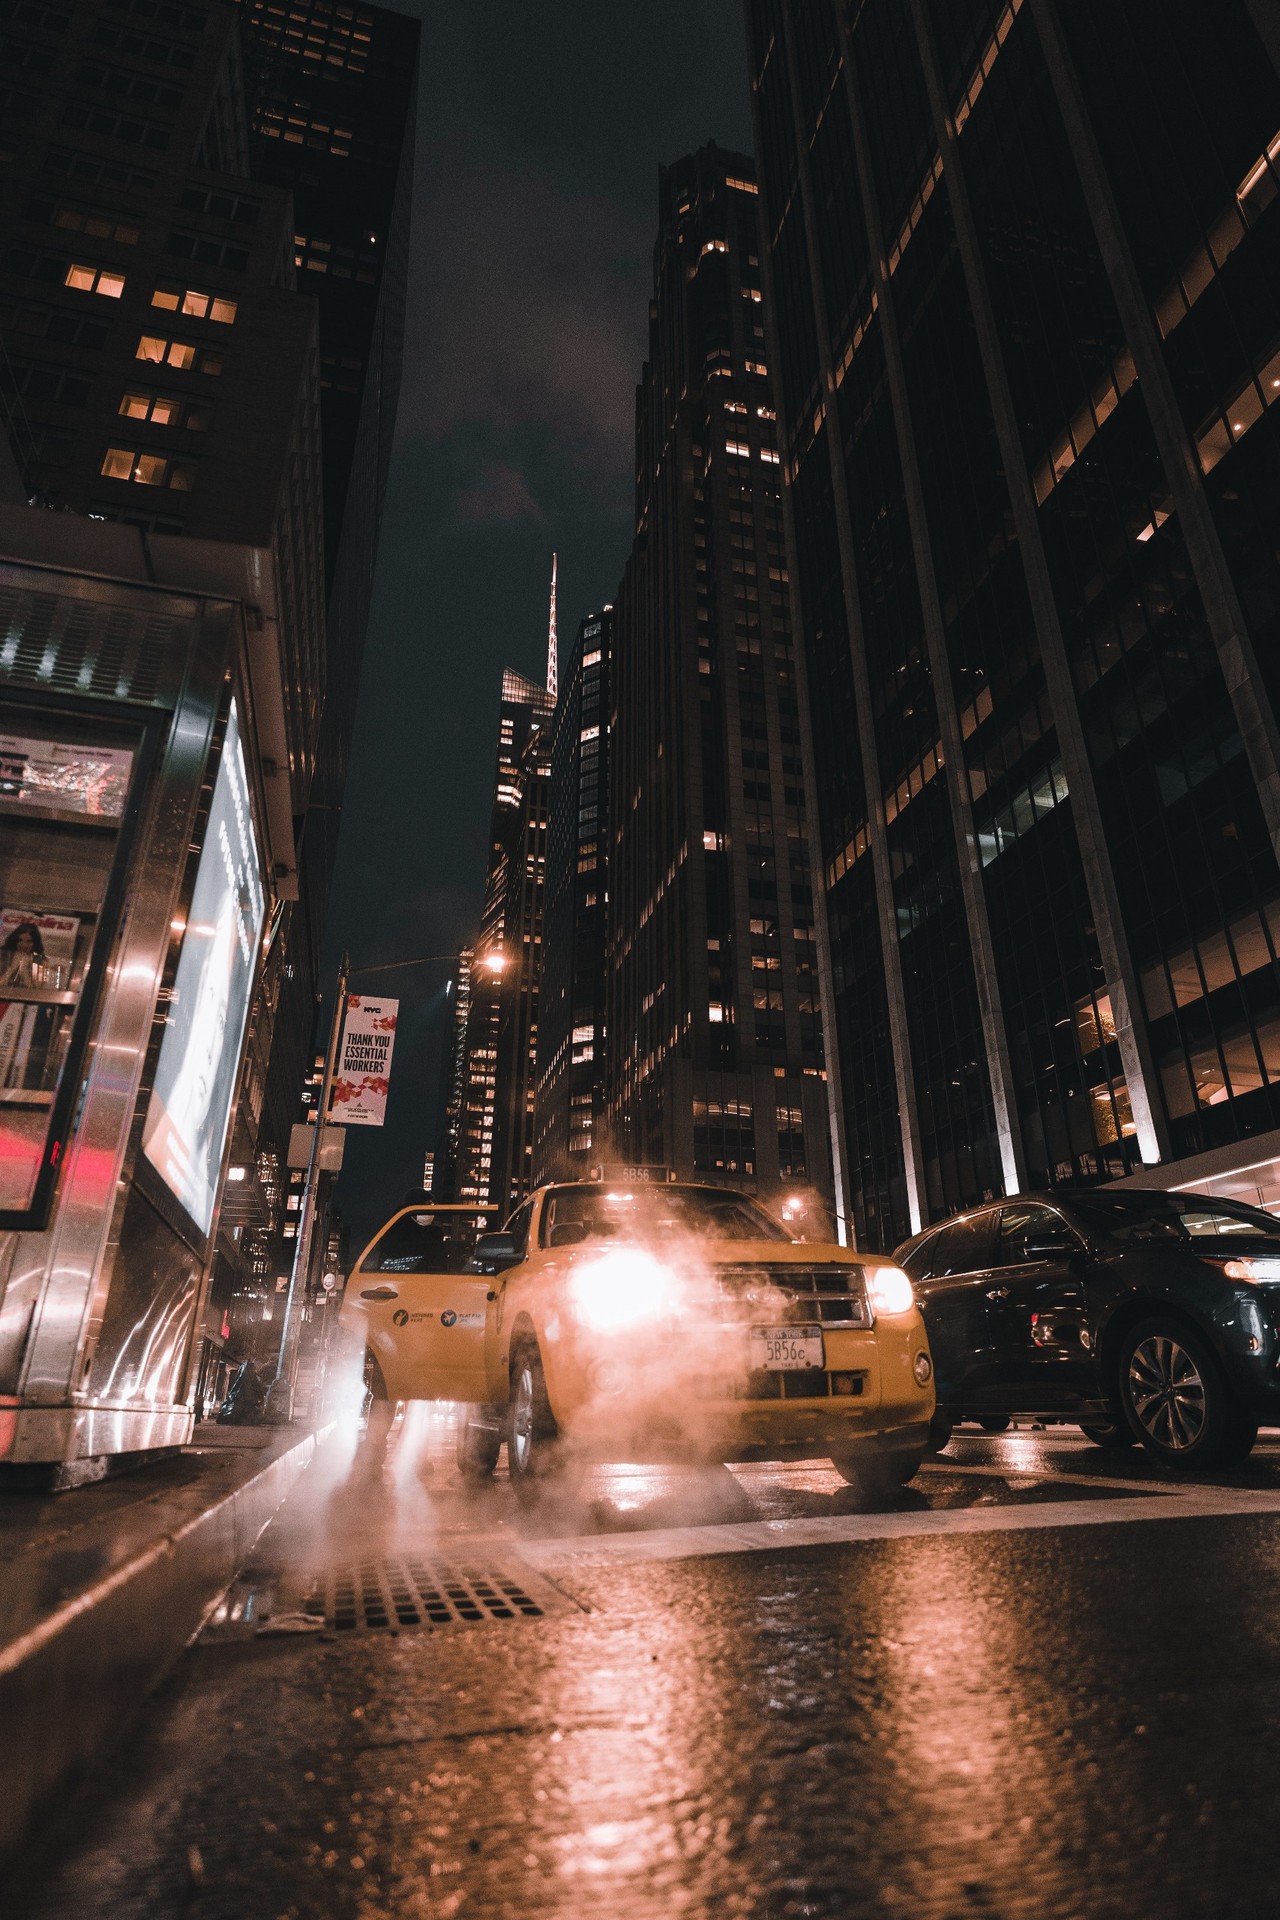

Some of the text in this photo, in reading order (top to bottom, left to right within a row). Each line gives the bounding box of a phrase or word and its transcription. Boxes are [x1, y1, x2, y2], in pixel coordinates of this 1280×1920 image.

[363, 1006, 381, 1014] NYC
[347, 1033, 390, 1048] THANK YOU
[345, 1046, 387, 1060] ESSENTIAL
[344, 1059, 385, 1073] WORKERS
[623, 1168, 649, 1182] 5B56
